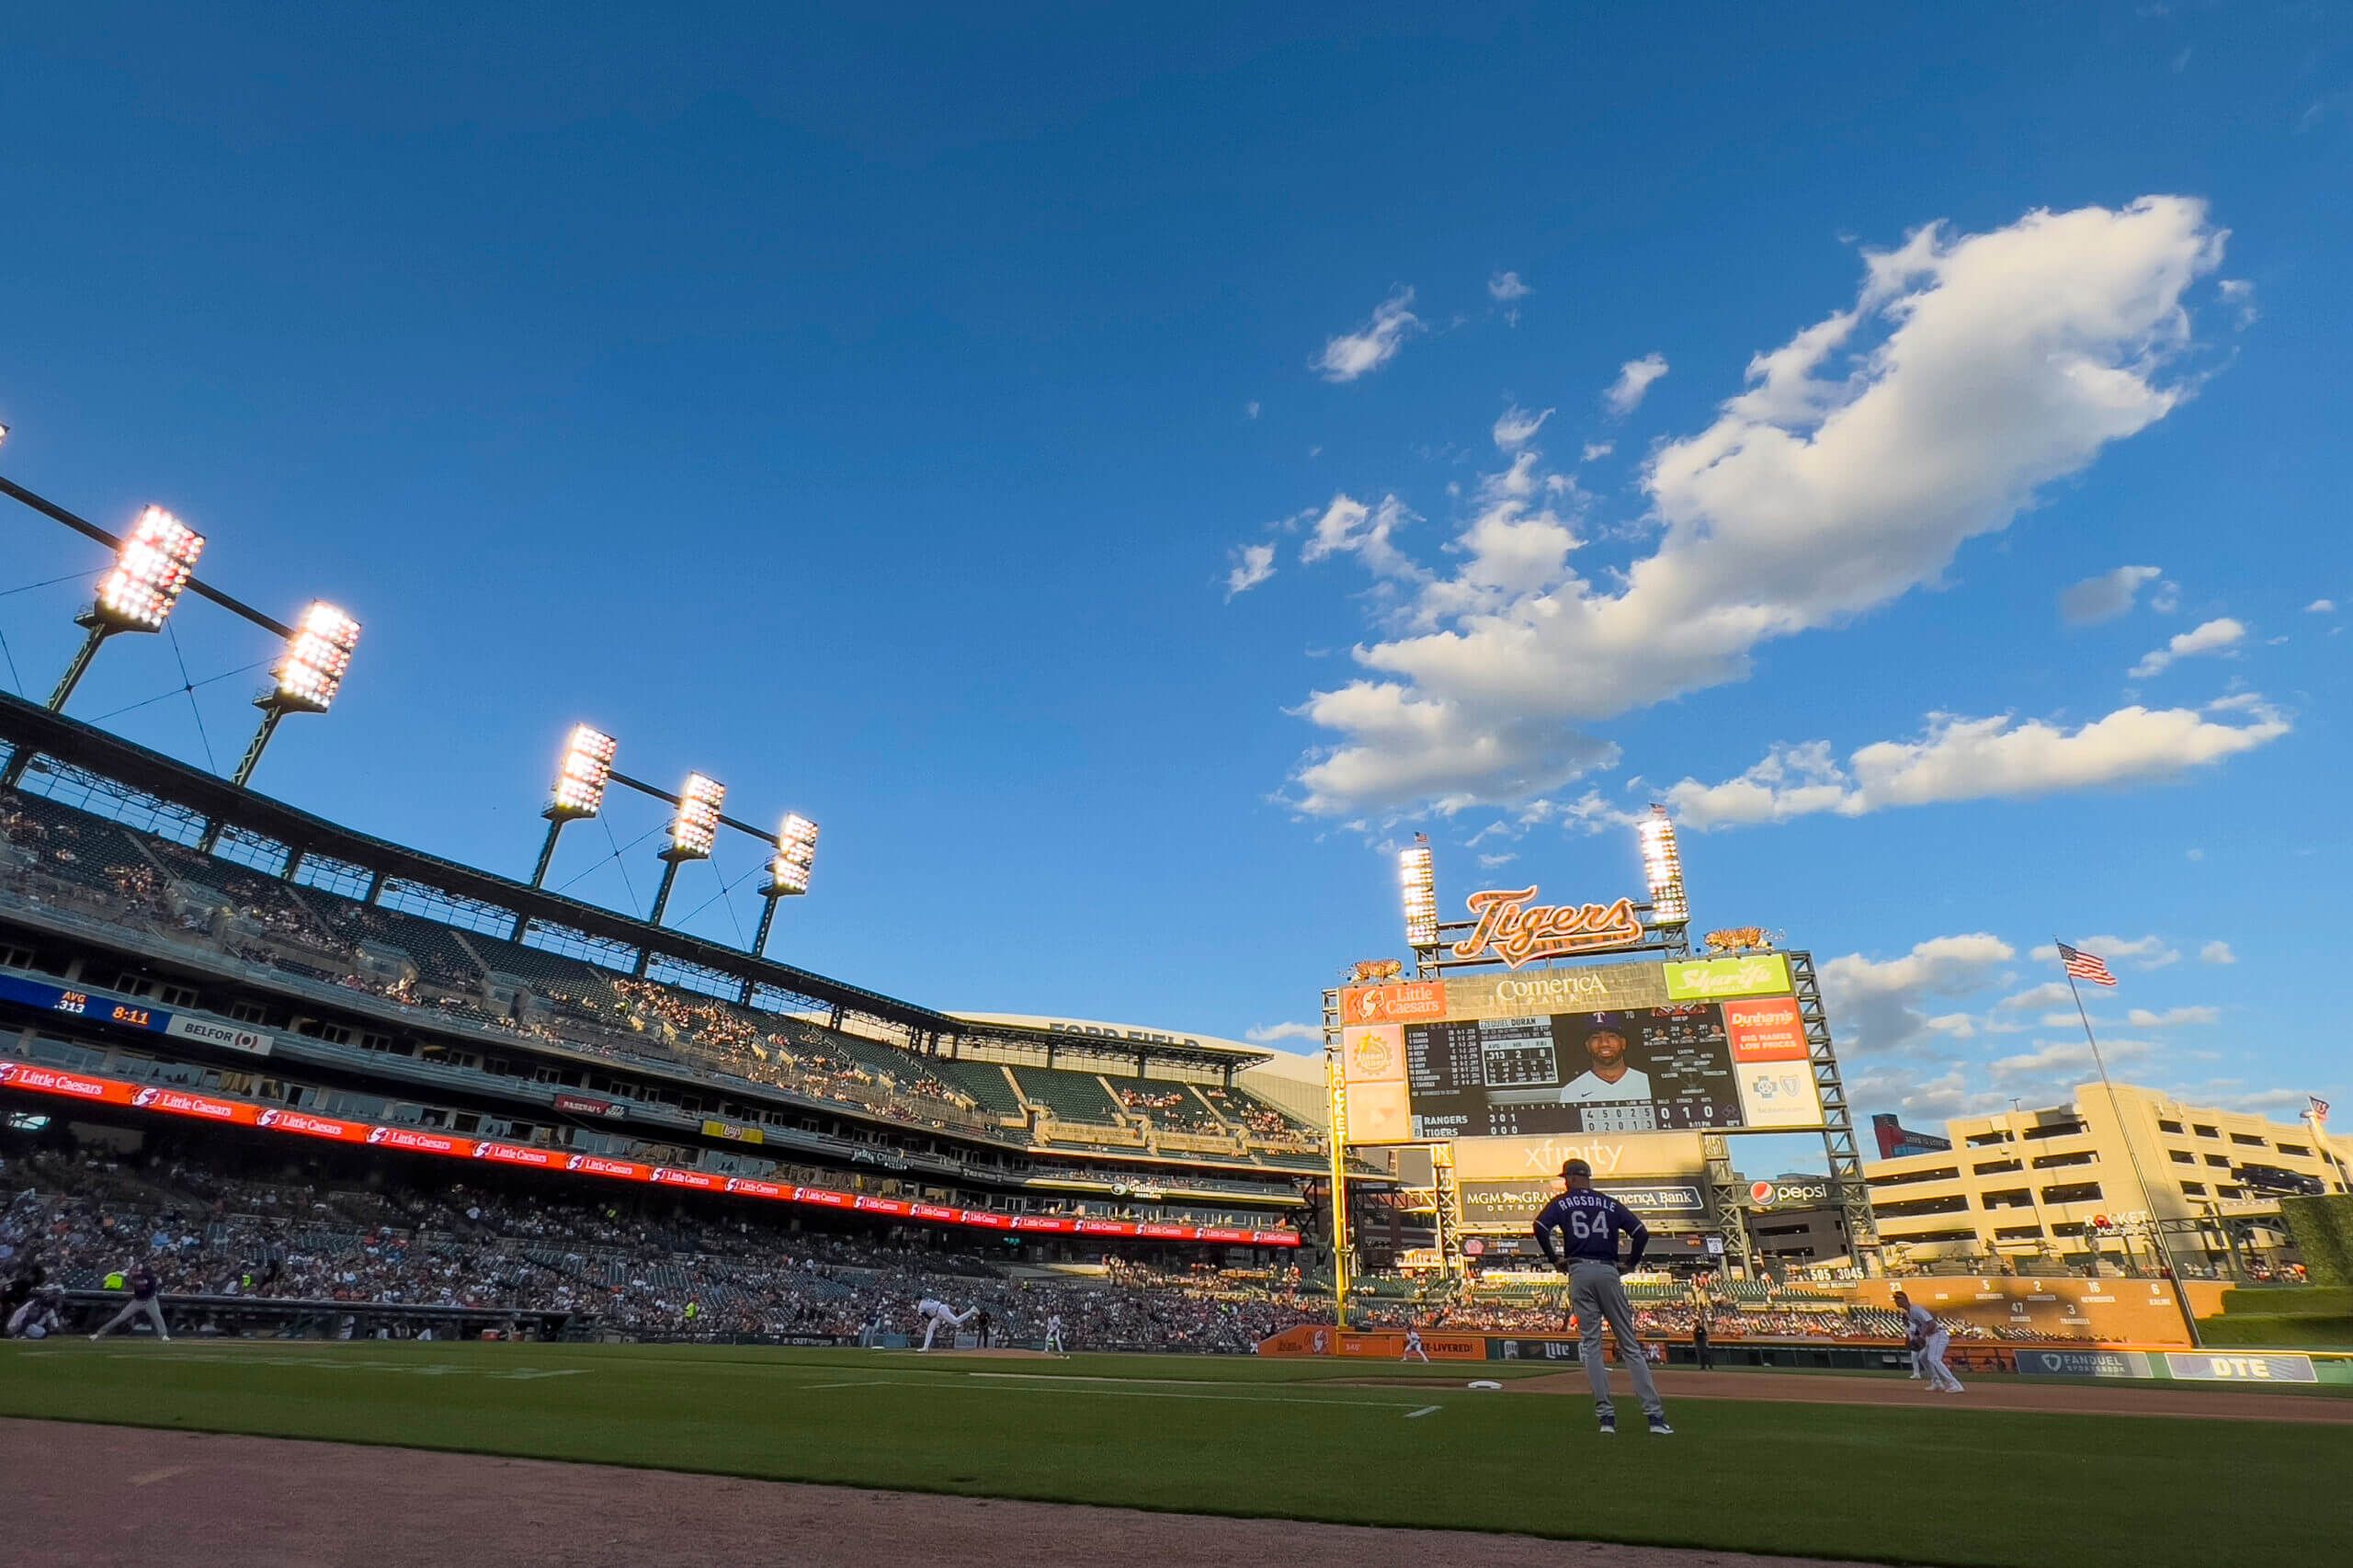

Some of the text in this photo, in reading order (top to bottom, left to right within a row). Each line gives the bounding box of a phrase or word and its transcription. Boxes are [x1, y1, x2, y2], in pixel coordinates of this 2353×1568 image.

[1452, 885, 1643, 969] Tigers
[63, 991, 86, 1003] AVG
[1397, 986, 1433, 1002] Little
[54, 1000, 85, 1014] .313
[1386, 1000, 1440, 1015] Caesars
[112, 1006, 151, 1025] 8:11
[1512, 1017, 1536, 1026] DURAN
[185, 1023, 234, 1042] BELFOR
[1486, 1051, 1506, 1061] .313
[1515, 1051, 1522, 1059] 2
[19, 1069, 103, 1096] Little Caesars
[162, 1095, 232, 1117] Little Caesars
[1661, 1106, 1713, 1119] 0 1 0
[282, 1114, 343, 1135] Little Caesars
[1424, 1115, 1468, 1125] RANGERS
[1489, 1114, 1495, 1122] 3
[1499, 1114, 1506, 1122] 0
[1587, 1110, 1594, 1119] 4
[1603, 1109, 1608, 1118] 5
[1617, 1108, 1622, 1117] 0
[1631, 1108, 1636, 1117] 2
[1644, 1108, 1650, 1116] 5
[1425, 1120, 1652, 1137] TIGERS 0 0 0 0 2 0 1 3
[392, 1132, 451, 1150] Little Caesars
[494, 1146, 547, 1164] Little Caesars
[1524, 1138, 1625, 1175] xfinity
[585, 1159, 633, 1175] Little Caesars
[667, 1171, 710, 1186] Little Caesars
[1467, 1192, 1501, 1204] MGM
[1658, 1191, 1693, 1203] Bank
[1778, 1183, 1827, 1201] pepsi
[1558, 1196, 1617, 1212] RAGSDALE
[1571, 1210, 1609, 1239] 64
[1810, 1267, 1864, 1281] 505 3045
[1983, 1279, 1991, 1290] 5
[2033, 1280, 2042, 1292] 2
[2087, 1281, 2101, 1293] 16
[2151, 1283, 2160, 1295] 6
[2011, 1302, 2024, 1313] 47
[2067, 1304, 2075, 1315] 3
[1544, 1342, 1570, 1359] Lite
[2063, 1356, 2123, 1367] FANDUEL
[2210, 1358, 2271, 1378] DTE
